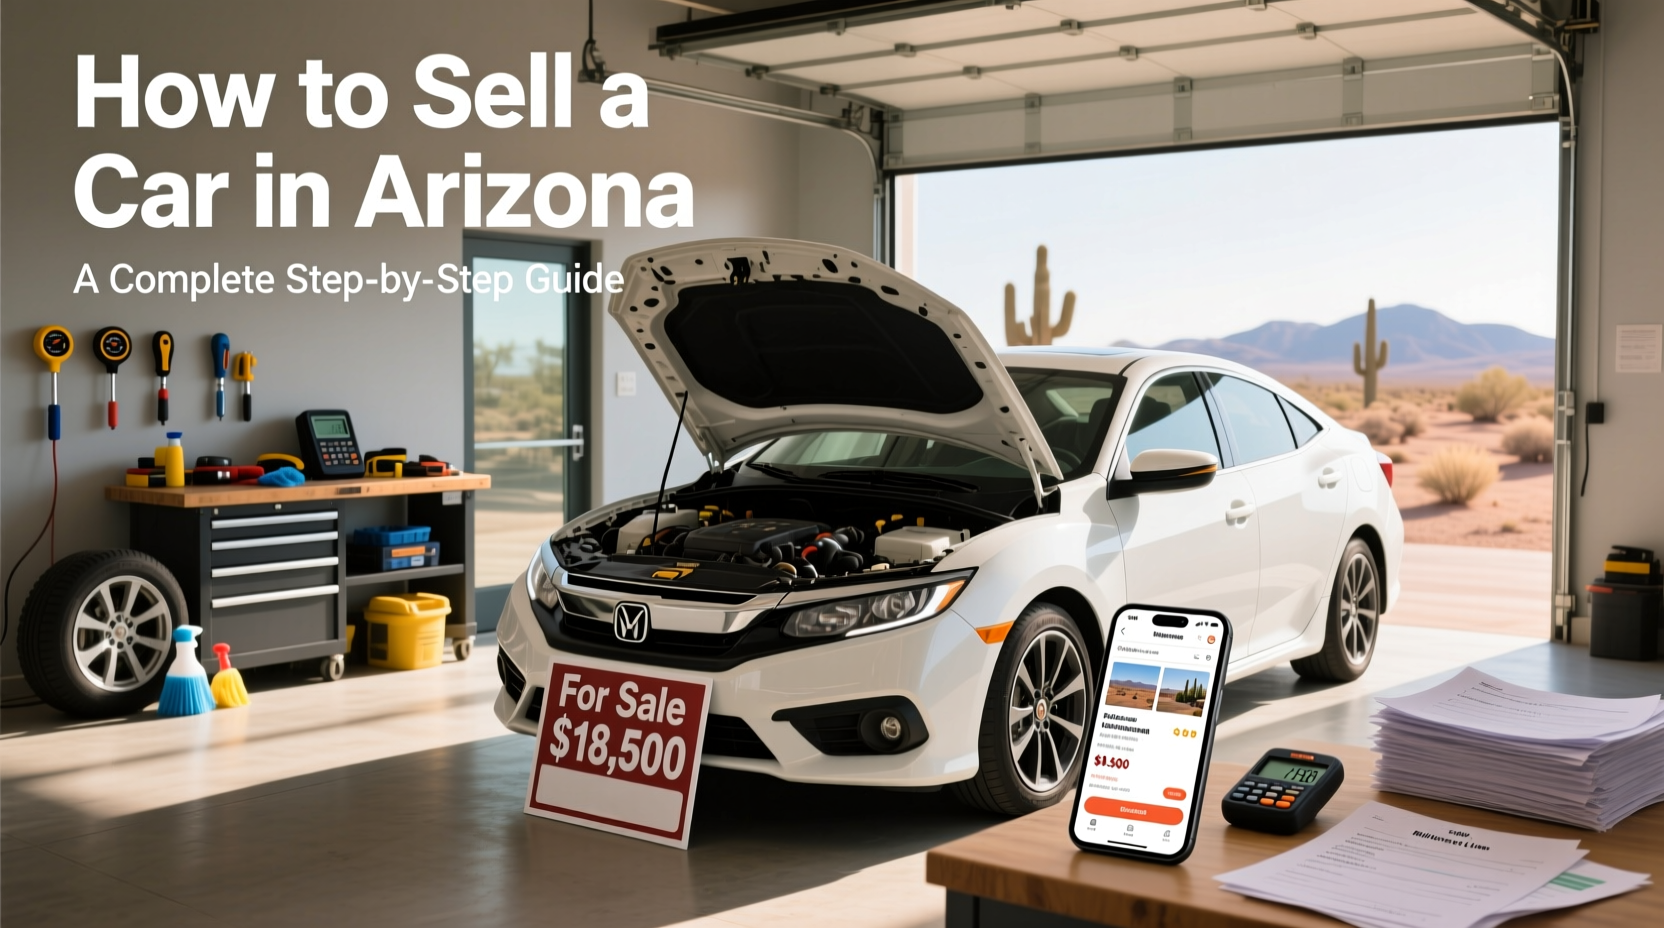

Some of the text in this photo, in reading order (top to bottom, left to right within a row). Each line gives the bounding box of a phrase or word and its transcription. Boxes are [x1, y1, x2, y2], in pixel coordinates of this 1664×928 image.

[559, 673, 686, 726] For Sale
[550, 713, 686, 780] $18,500
